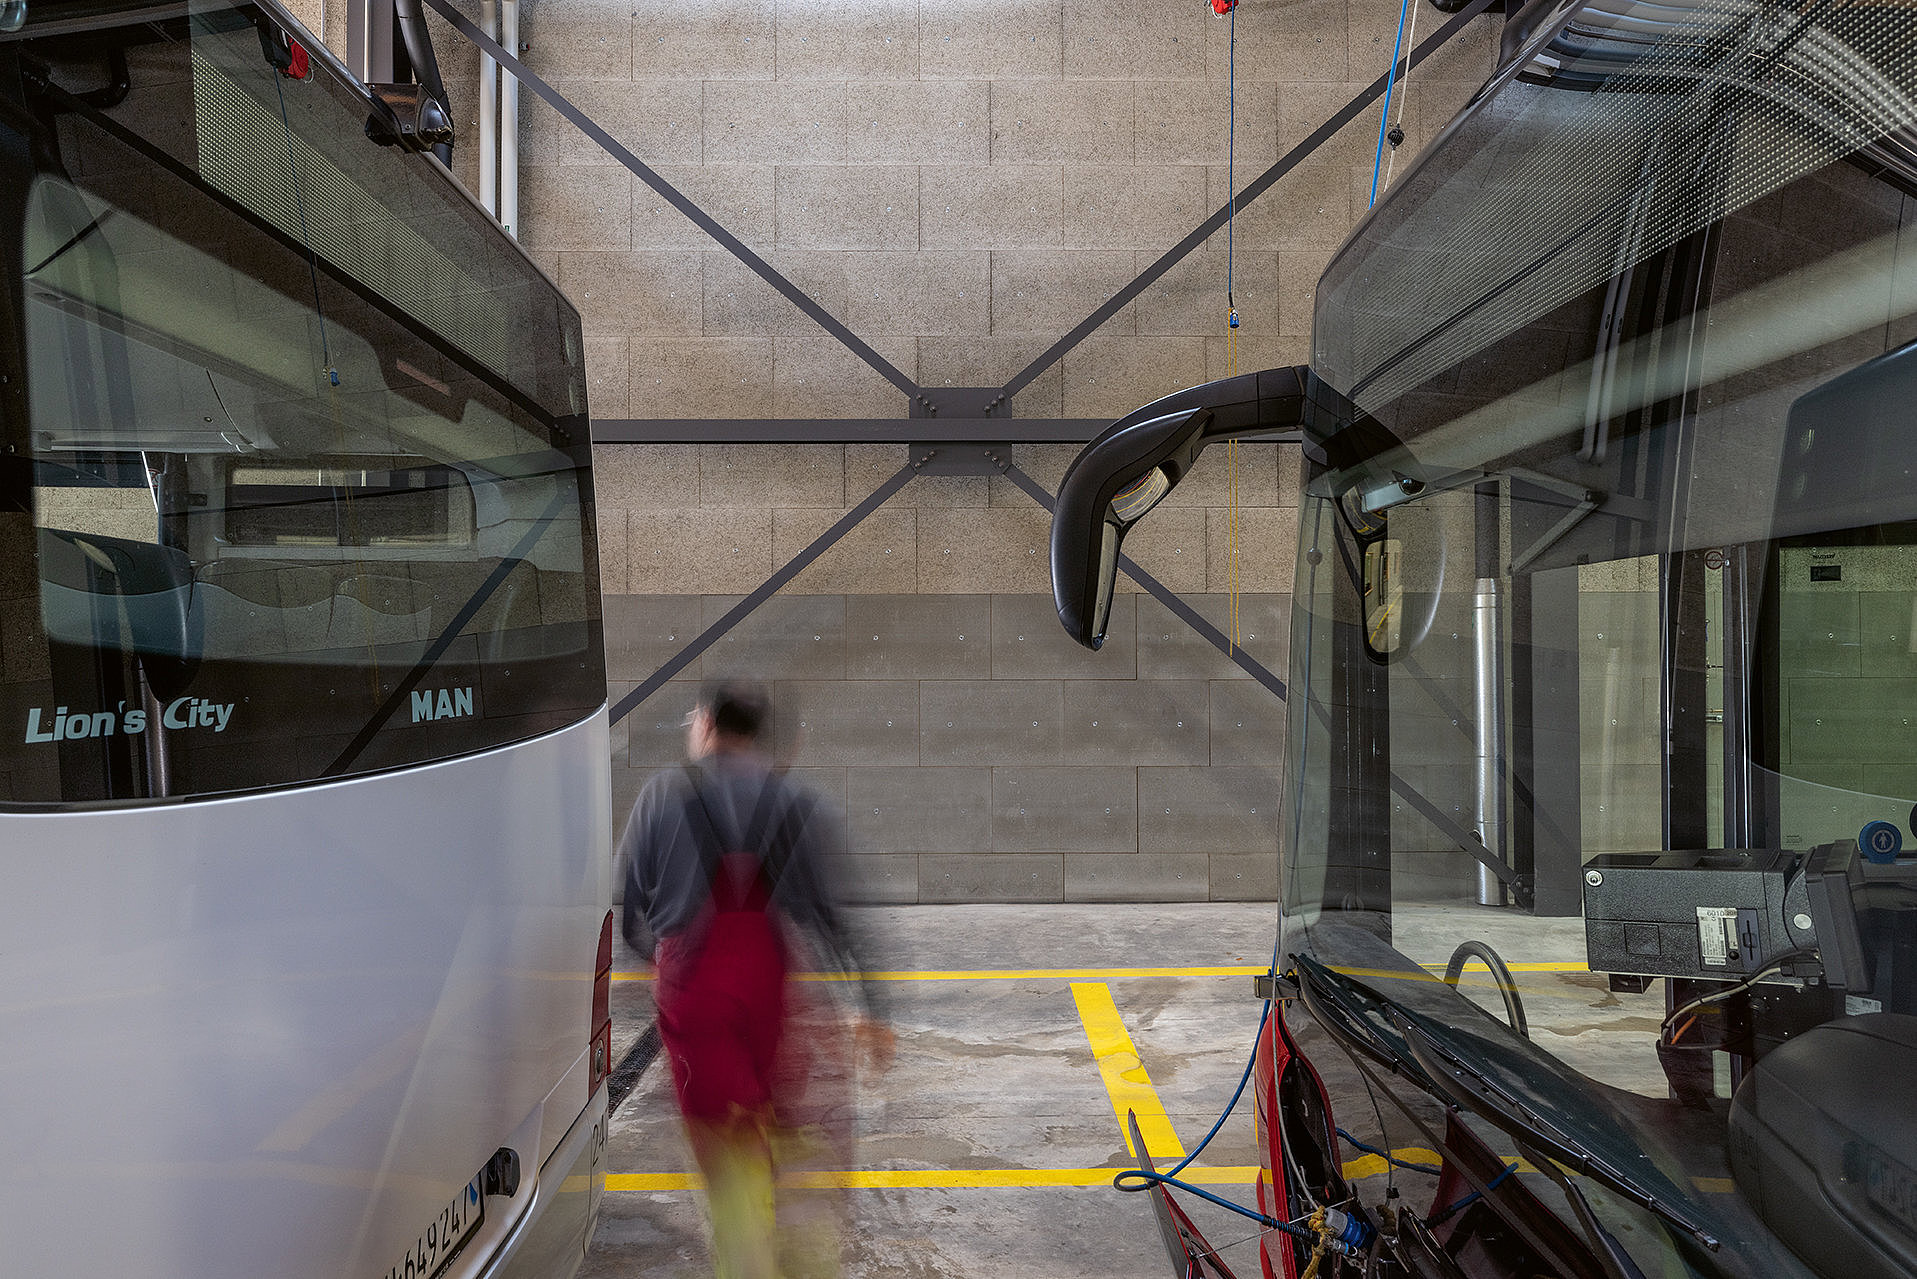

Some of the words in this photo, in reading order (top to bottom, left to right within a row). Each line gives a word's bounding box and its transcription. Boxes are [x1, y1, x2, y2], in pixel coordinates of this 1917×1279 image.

[24, 700, 147, 744] Lion's
[162, 696, 235, 733] City
[411, 687, 473, 723] MAN
